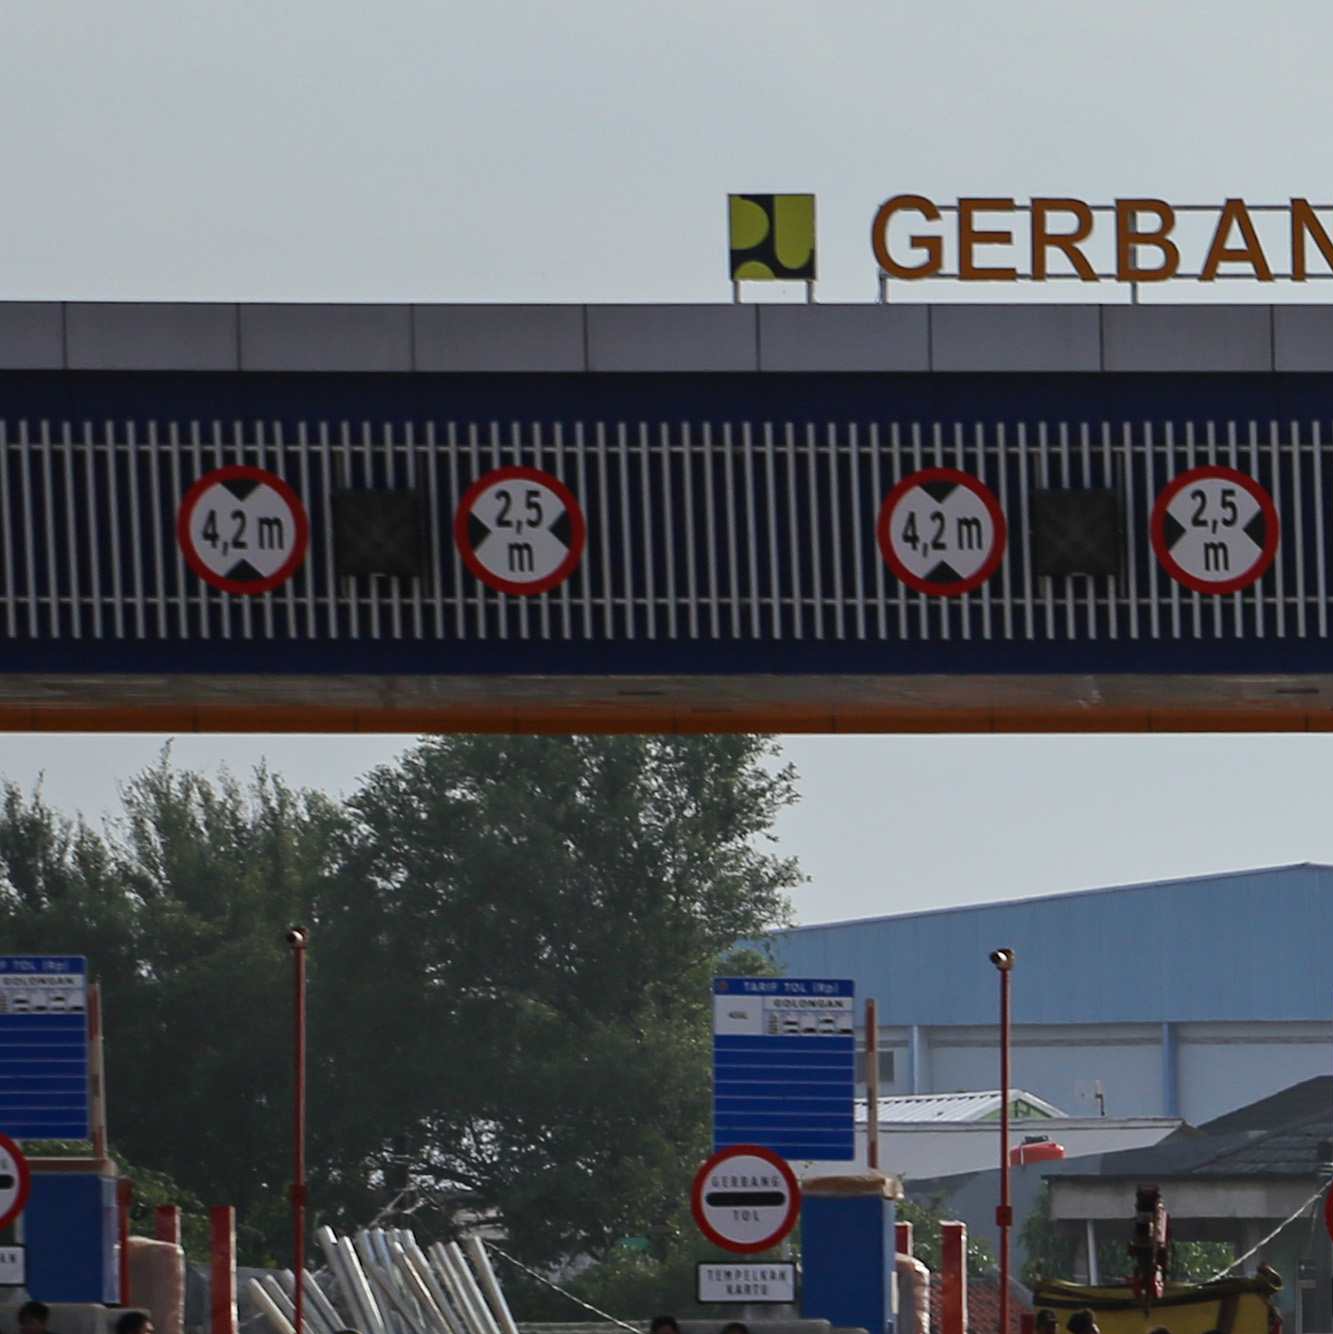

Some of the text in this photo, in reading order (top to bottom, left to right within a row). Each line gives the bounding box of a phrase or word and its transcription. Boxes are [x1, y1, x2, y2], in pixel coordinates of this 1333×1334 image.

[199, 508, 286, 558] 4,2 m
[493, 489, 545, 536] 2,5
[900, 510, 985, 559] 4,2 m
[1189, 488, 1240, 535] 2,5
[506, 541, 536, 573] m
[1202, 541, 1231, 572] m
